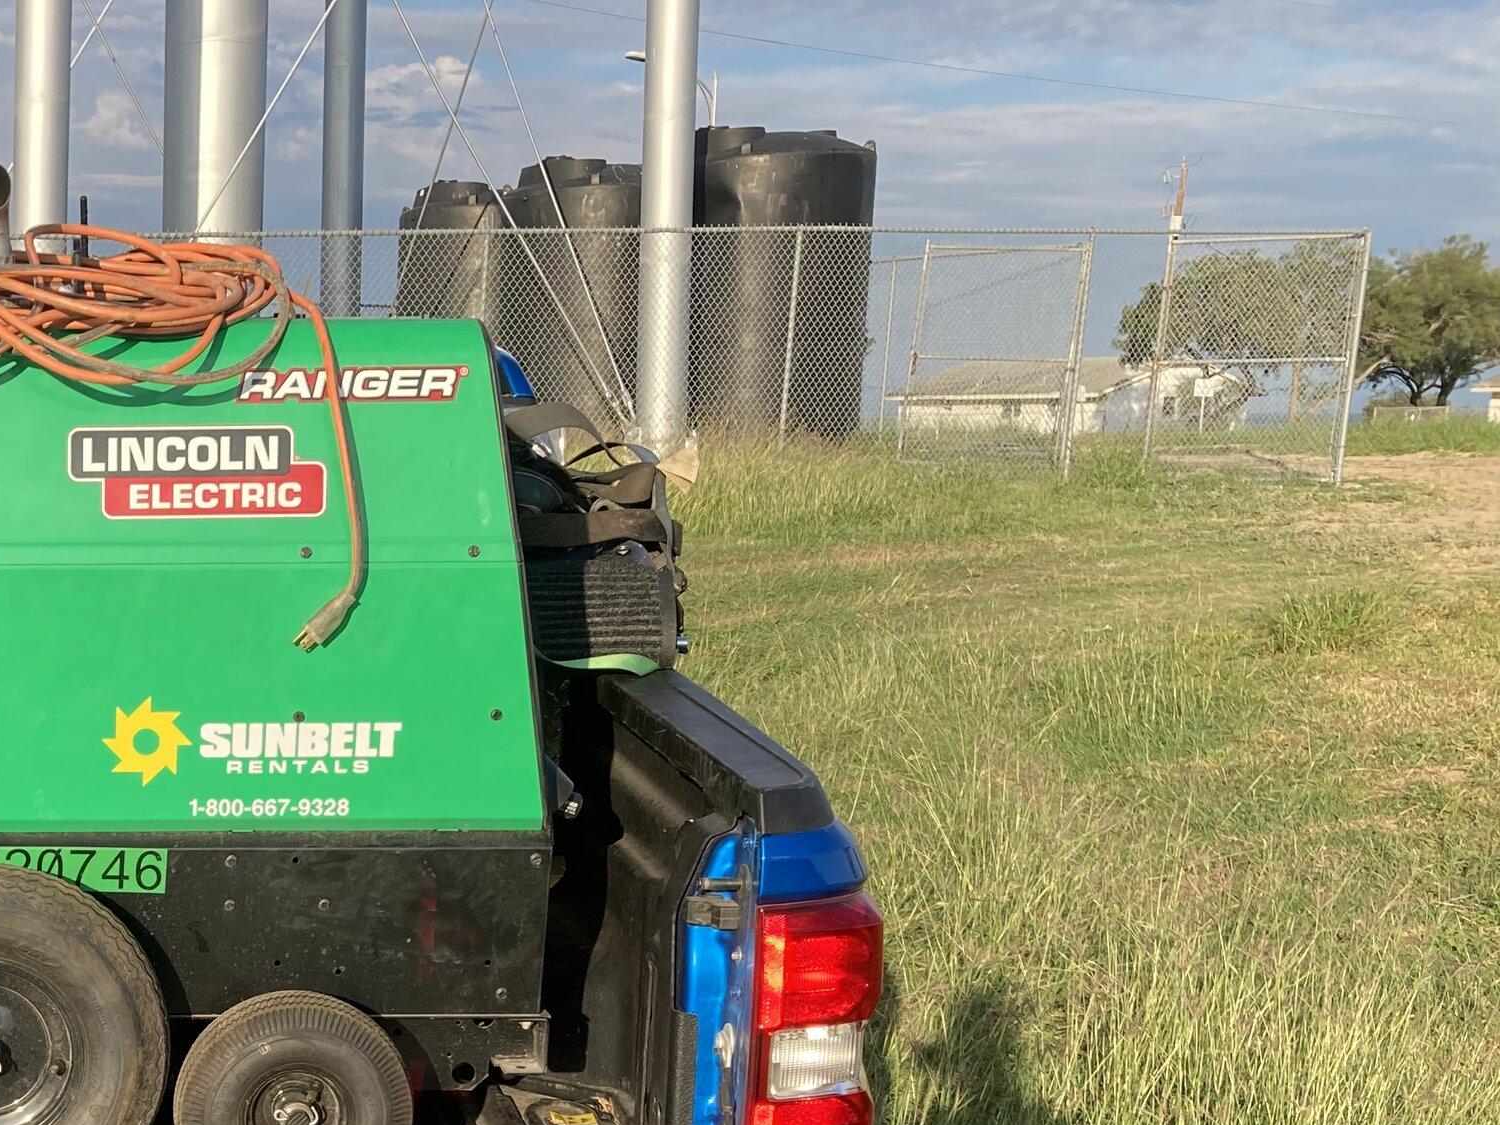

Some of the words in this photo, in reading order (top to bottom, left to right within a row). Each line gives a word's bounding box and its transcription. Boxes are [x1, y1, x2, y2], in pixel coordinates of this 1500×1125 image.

[239, 367, 457, 400] RANGER
[81, 434, 279, 472] LINCOLN
[128, 481, 302, 510] ELECTRIC
[198, 721, 403, 758] SUNBELT
[226, 759, 370, 774] RENTALS
[188, 798, 350, 817] 1-800-667-9328
